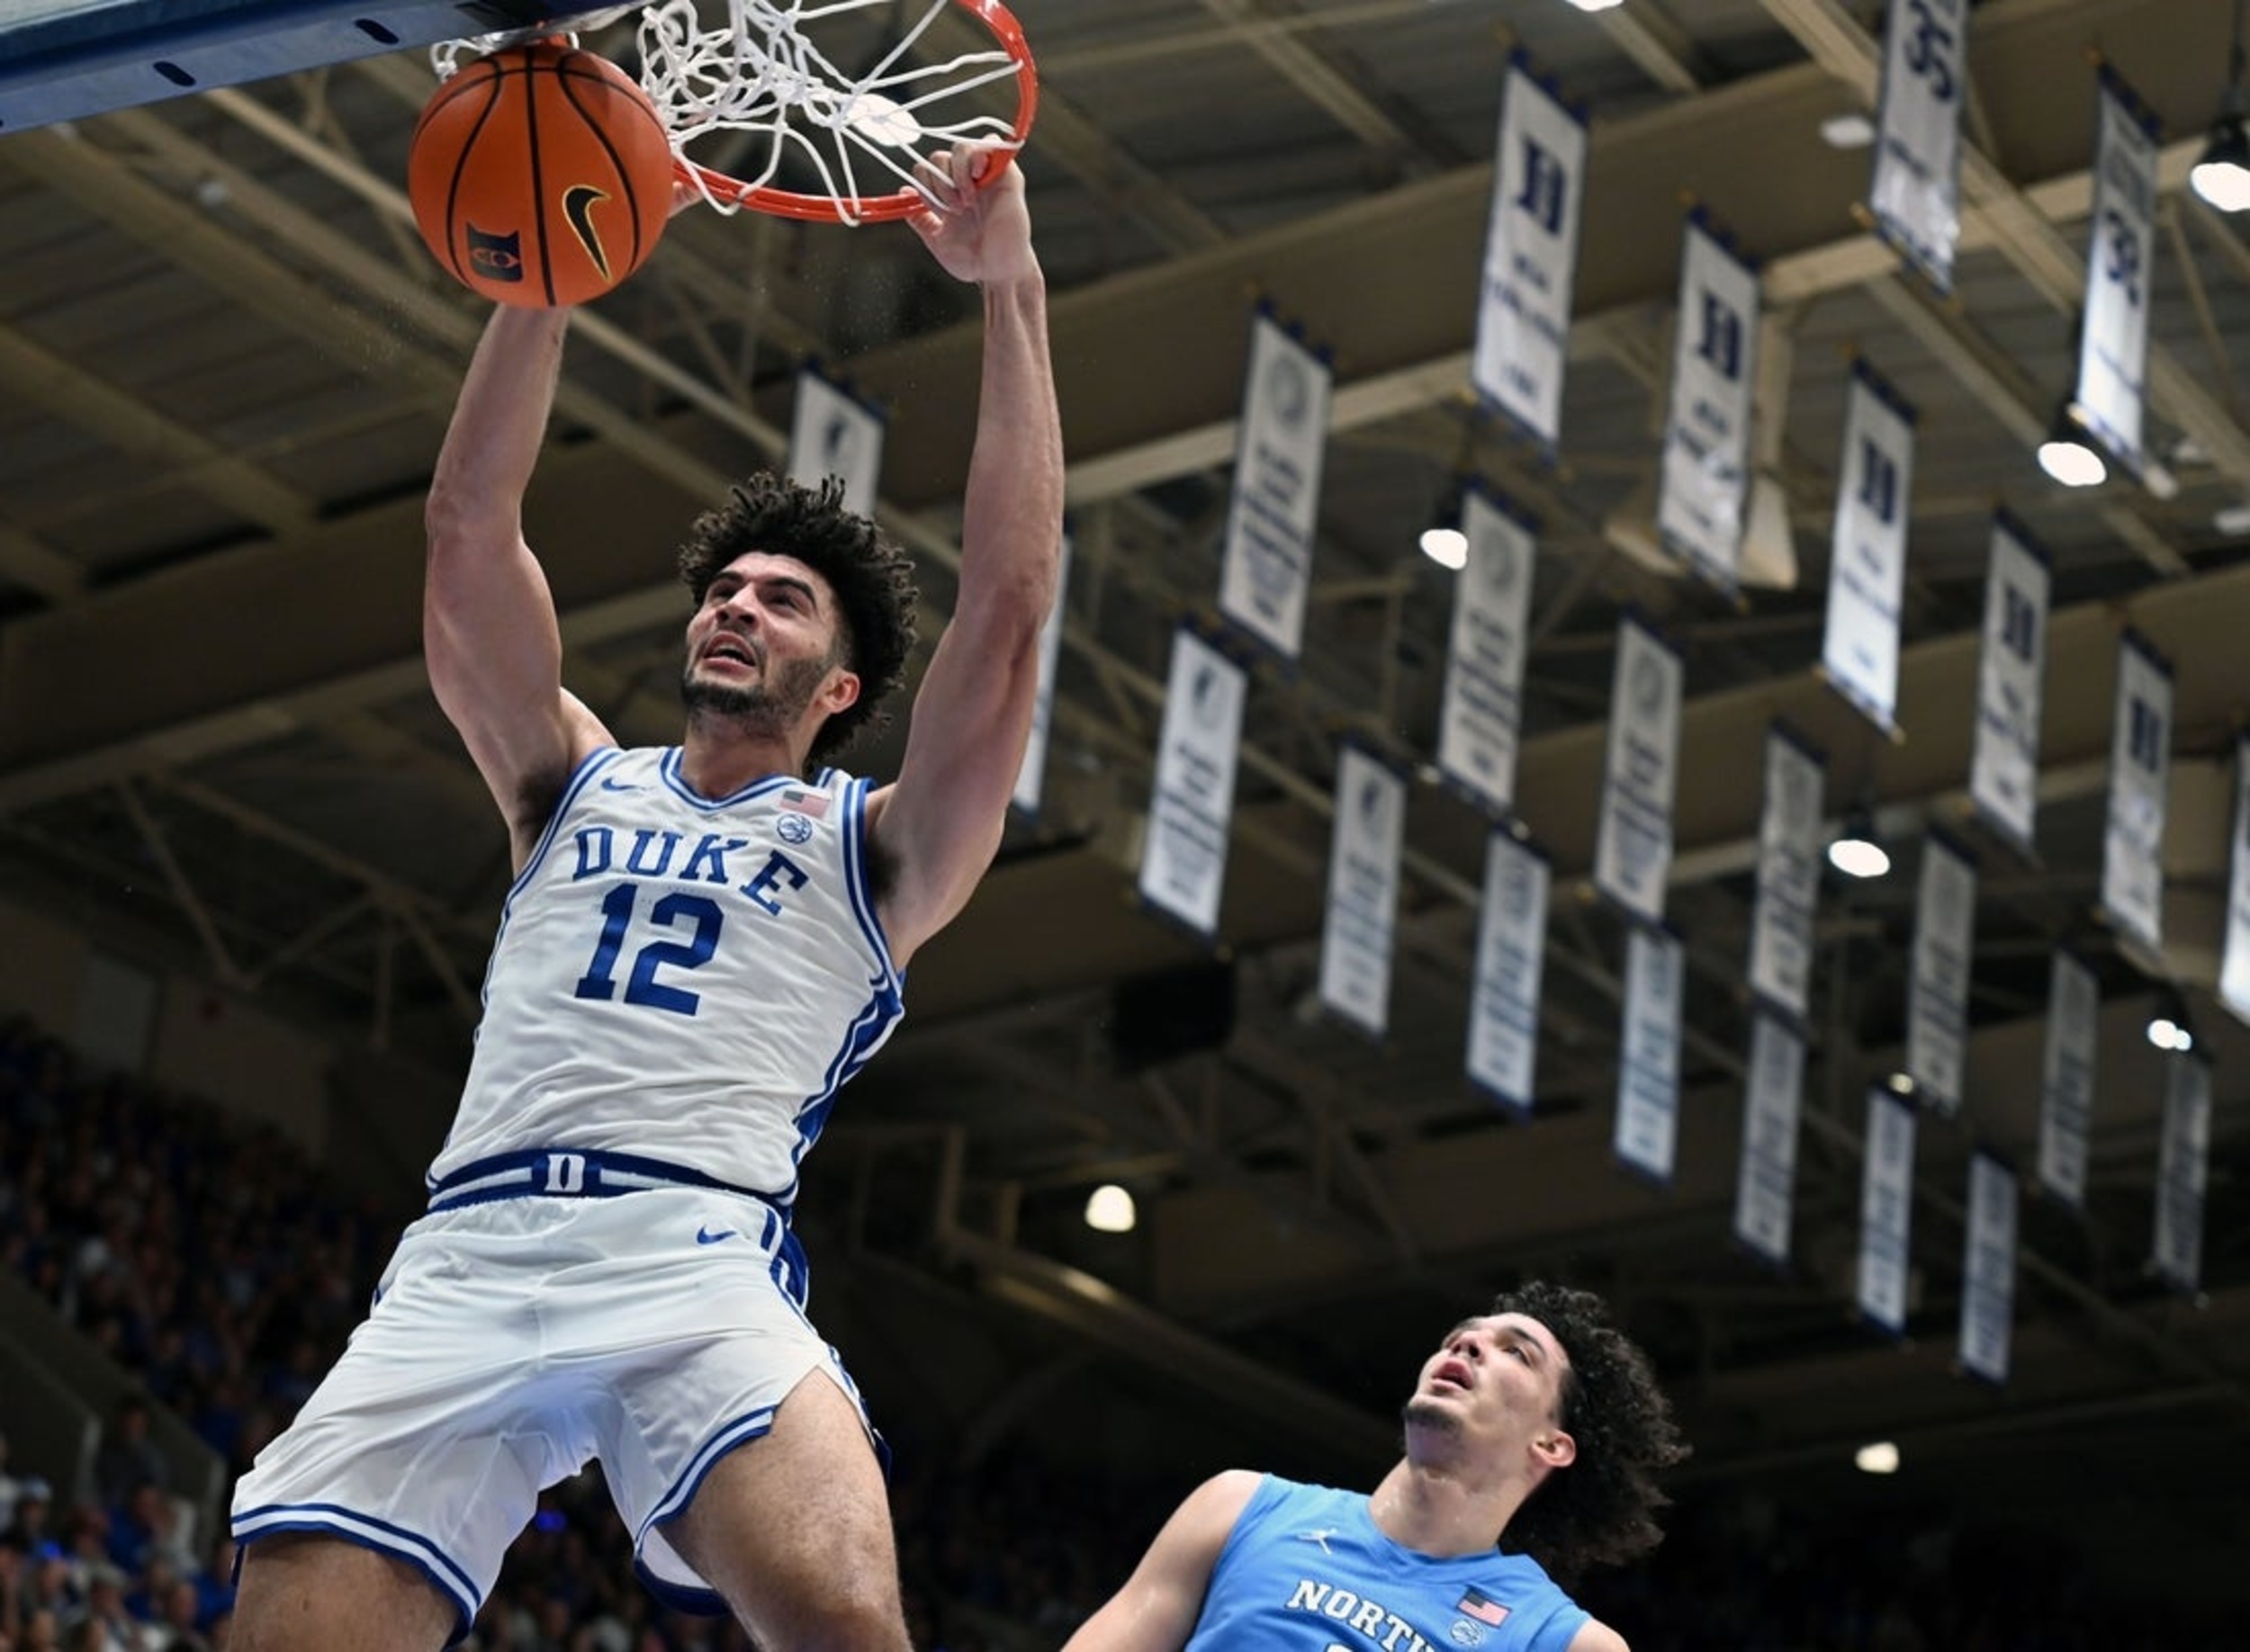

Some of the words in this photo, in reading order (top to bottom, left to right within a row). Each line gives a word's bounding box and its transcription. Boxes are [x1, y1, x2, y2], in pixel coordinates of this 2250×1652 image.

[572, 827, 809, 917] DUKE
[574, 883, 724, 1016] 12
[544, 1154, 586, 1193] D
